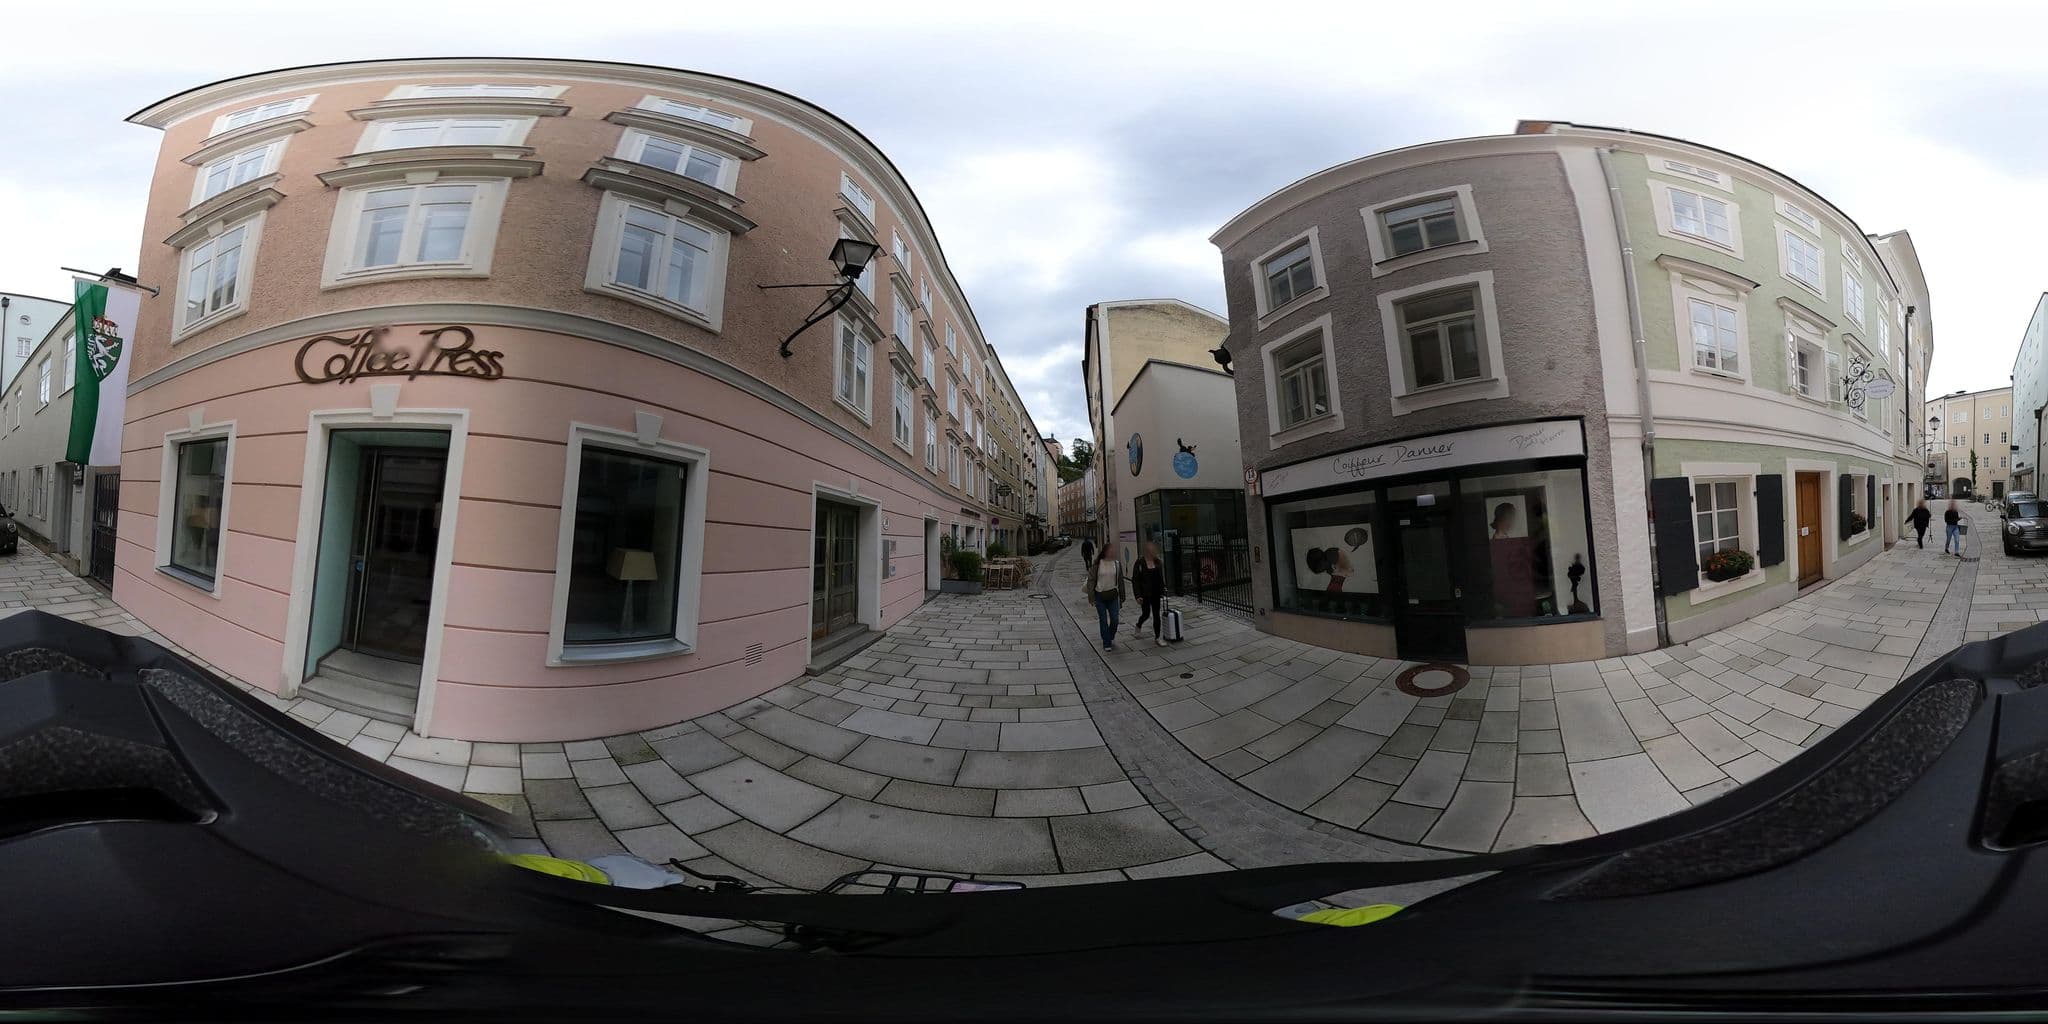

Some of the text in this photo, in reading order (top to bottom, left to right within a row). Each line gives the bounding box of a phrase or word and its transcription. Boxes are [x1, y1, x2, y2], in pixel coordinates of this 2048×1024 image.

[295, 326, 504, 384] Coffee Press
[1333, 442, 1455, 477] Coiffeur Danner
